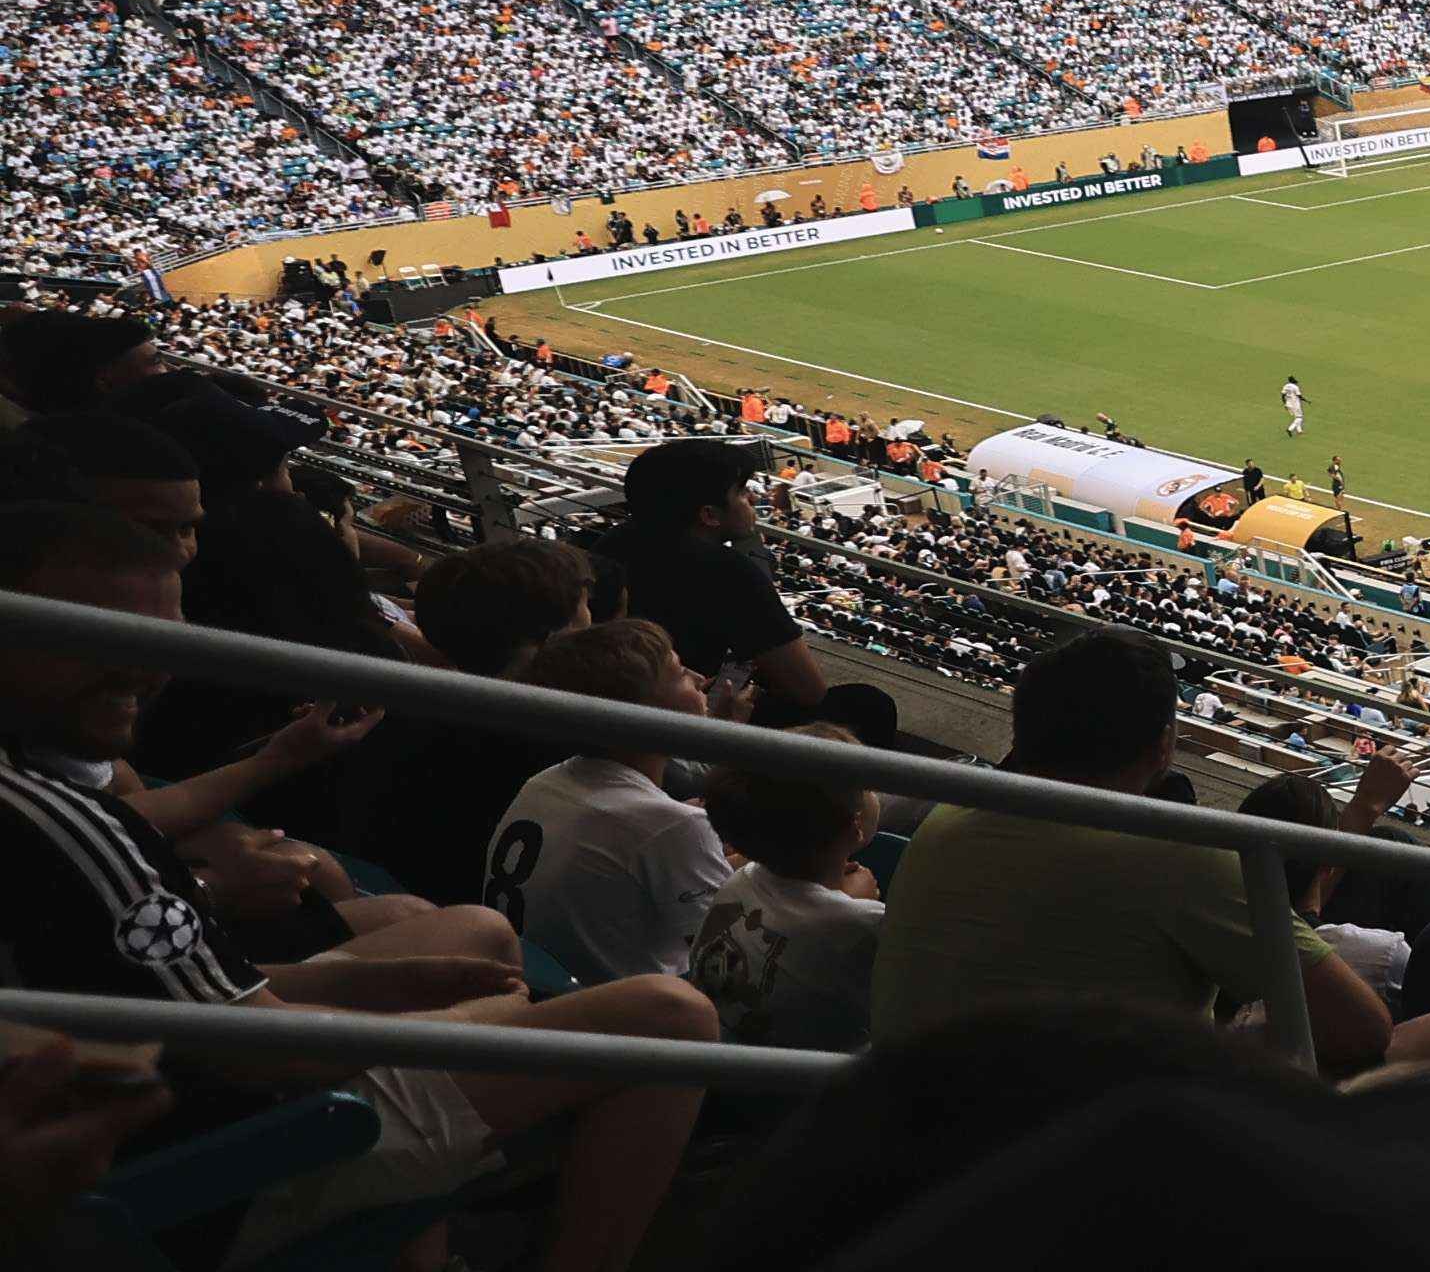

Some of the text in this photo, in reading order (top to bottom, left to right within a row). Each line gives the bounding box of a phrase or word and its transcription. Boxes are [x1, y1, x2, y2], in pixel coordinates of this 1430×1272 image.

[1310, 139, 1378, 160] INVESTED
[1380, 138, 1394, 149] IN
[1003, 174, 1163, 210] INVESTED IN BETTER
[611, 227, 821, 271] INVESTED IN BETTER
[485, 818, 544, 936] 8
